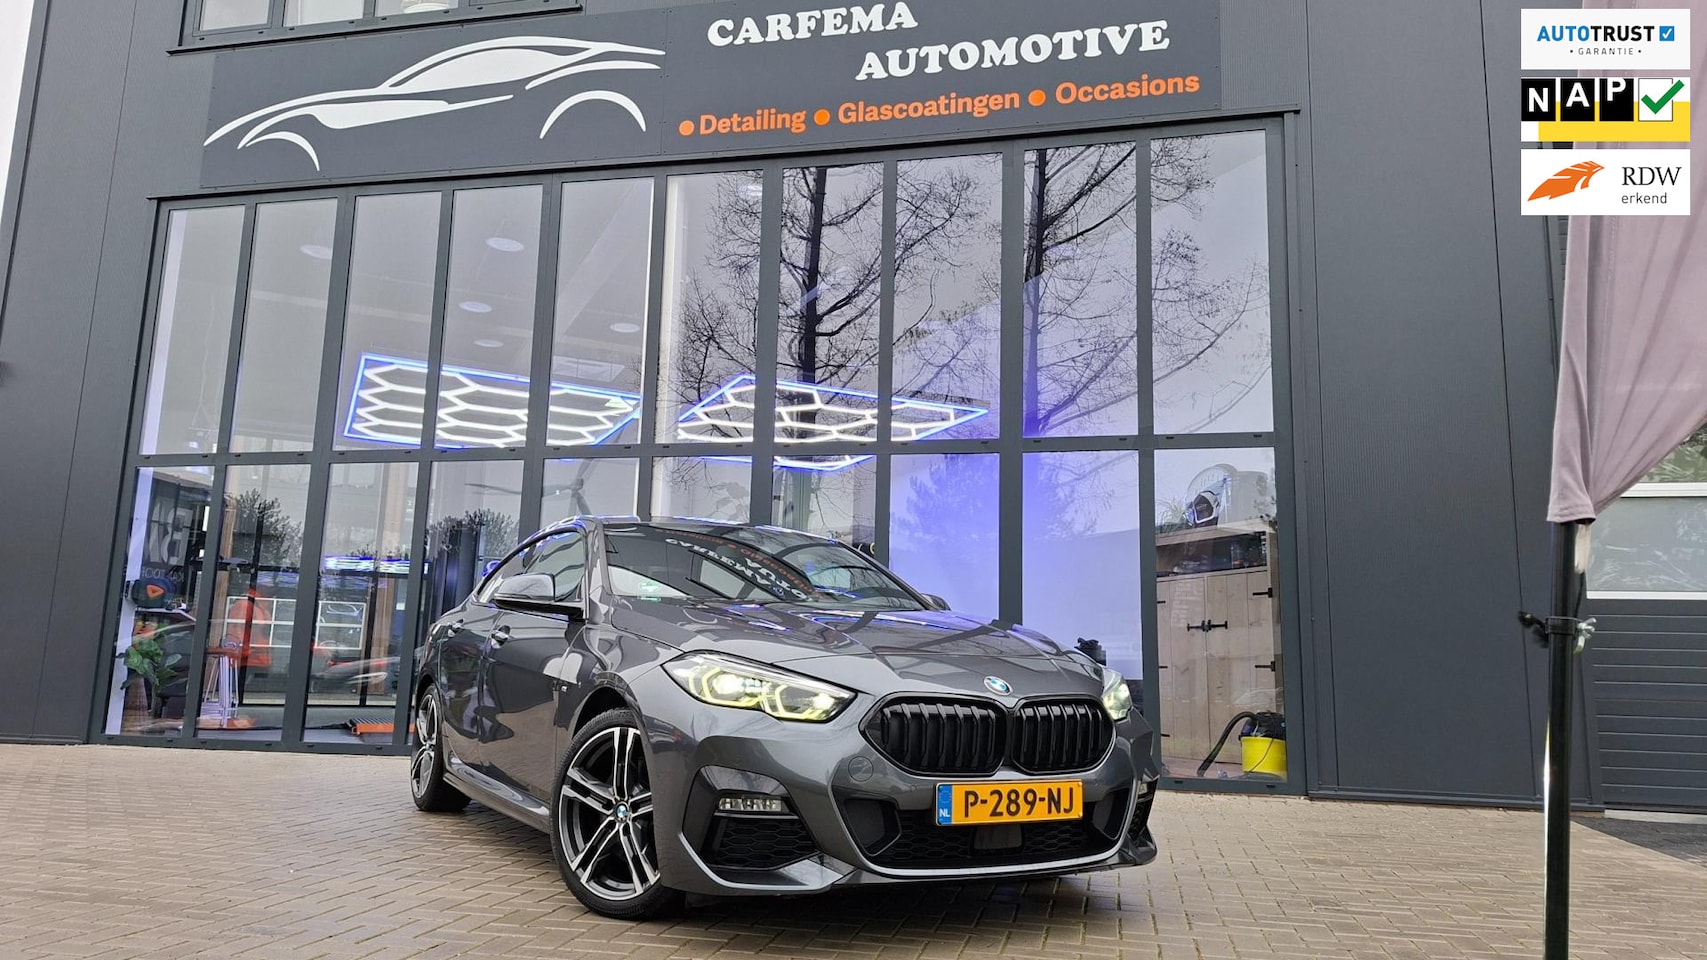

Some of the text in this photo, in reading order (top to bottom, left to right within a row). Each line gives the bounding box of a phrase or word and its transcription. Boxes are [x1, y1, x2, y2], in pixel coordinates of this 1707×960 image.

[707, 2, 918, 46] CARFEMA
[855, 19, 1170, 81] AUTOMOTIVE
[700, 73, 1200, 135] Detailing Glascoatingen Occasions
[939, 787, 1074, 818] NL P-289-NJ
